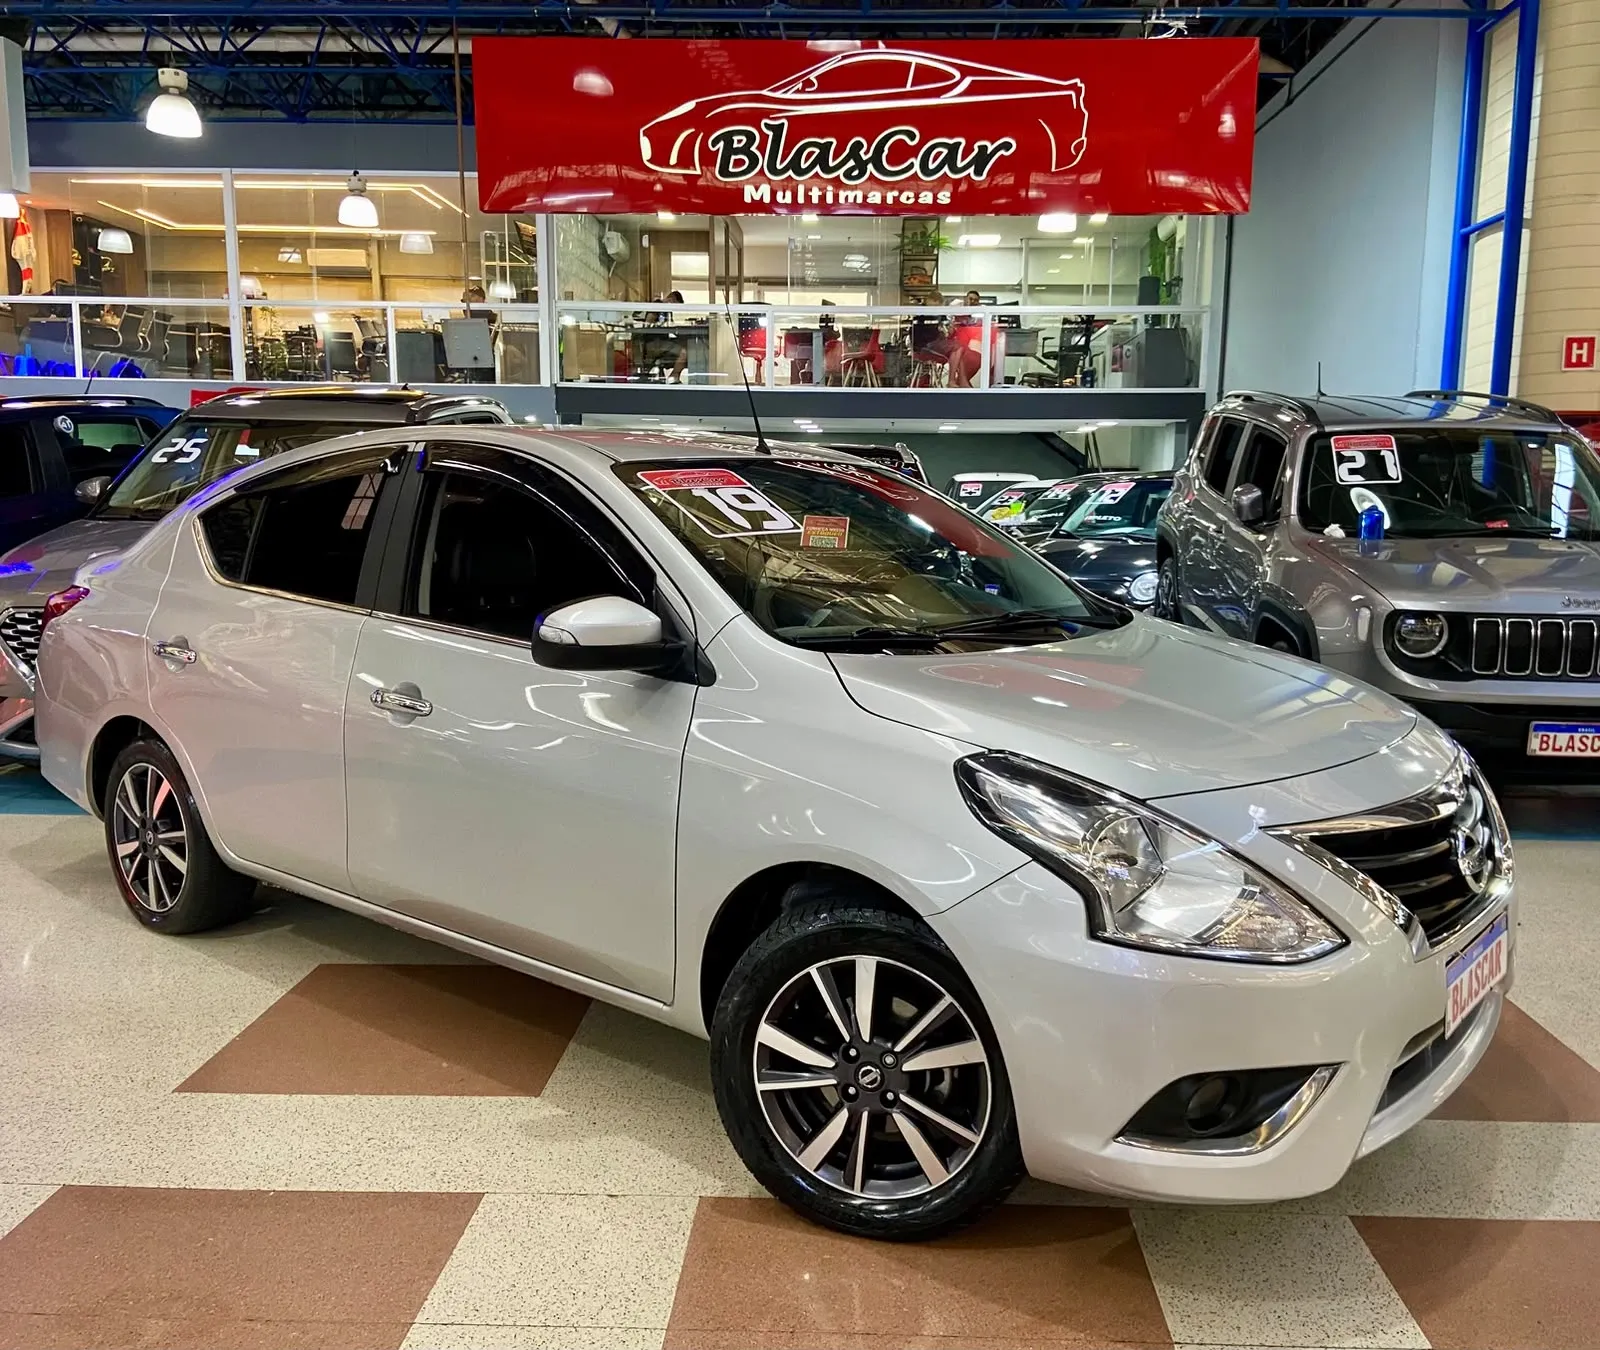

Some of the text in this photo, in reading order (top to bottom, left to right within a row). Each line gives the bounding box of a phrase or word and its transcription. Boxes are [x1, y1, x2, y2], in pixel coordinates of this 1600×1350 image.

[708, 118, 1017, 185] BlasCar
[743, 184, 952, 205] Multimarcas
[1571, 342, 1589, 363] H
[151, 438, 208, 463] 25
[1338, 449, 1398, 482] 21
[692, 486, 794, 531] 19
[1451, 939, 1502, 1023] BLASCAR
